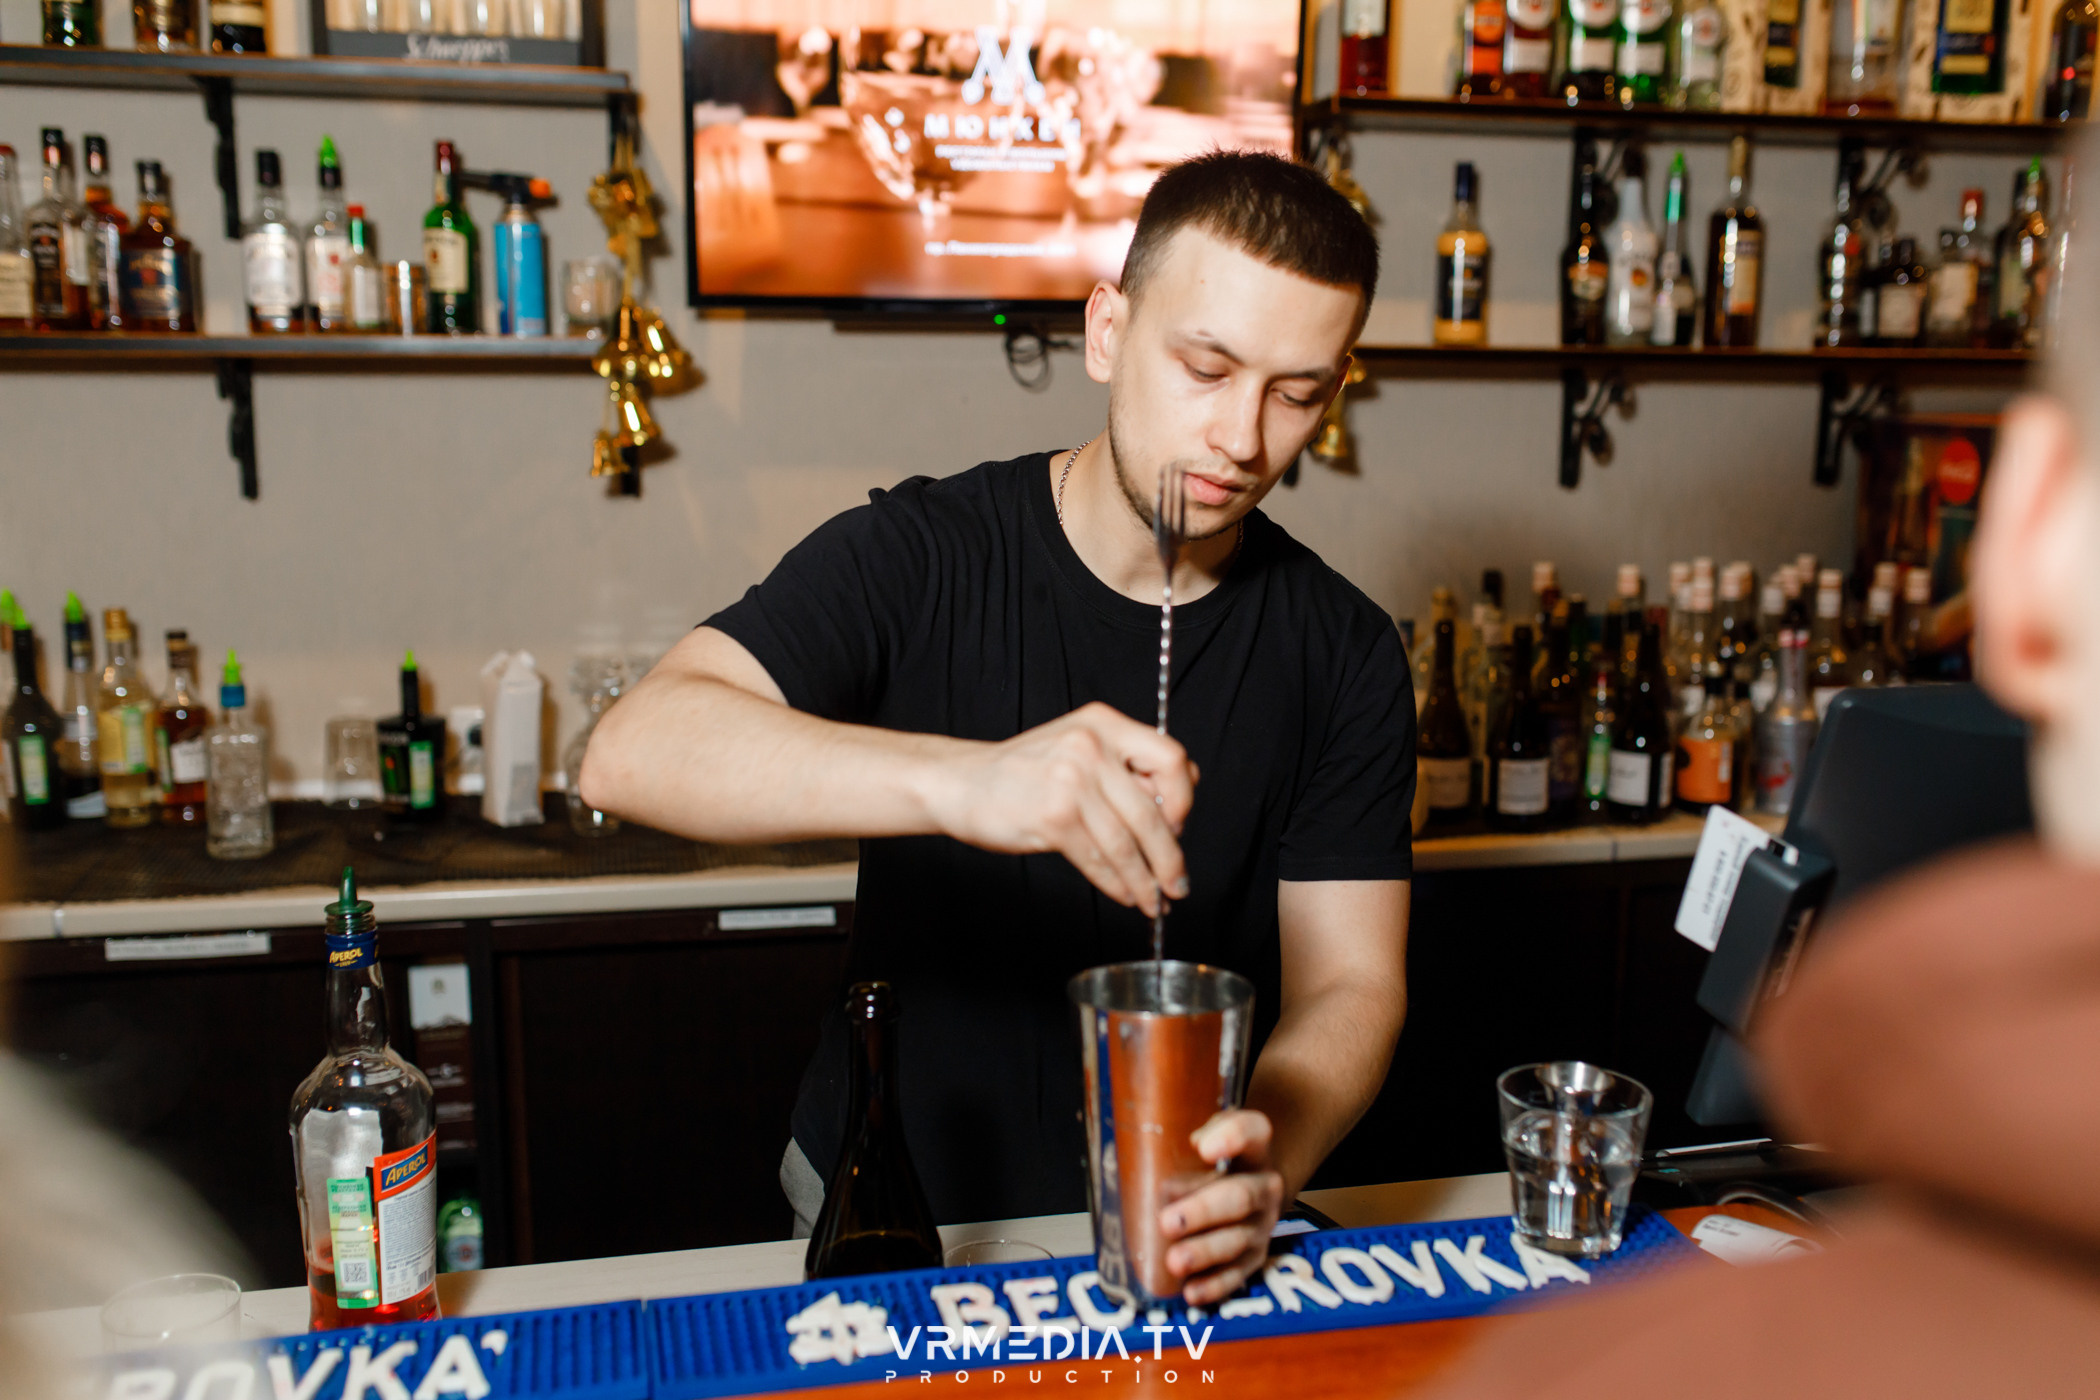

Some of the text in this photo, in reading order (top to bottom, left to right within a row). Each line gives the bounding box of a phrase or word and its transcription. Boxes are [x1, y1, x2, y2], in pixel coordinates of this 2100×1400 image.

[329, 947, 363, 963] APEROL
[385, 1153, 426, 1186] APEROL
[930, 1232, 1591, 1350] BECROVKA
